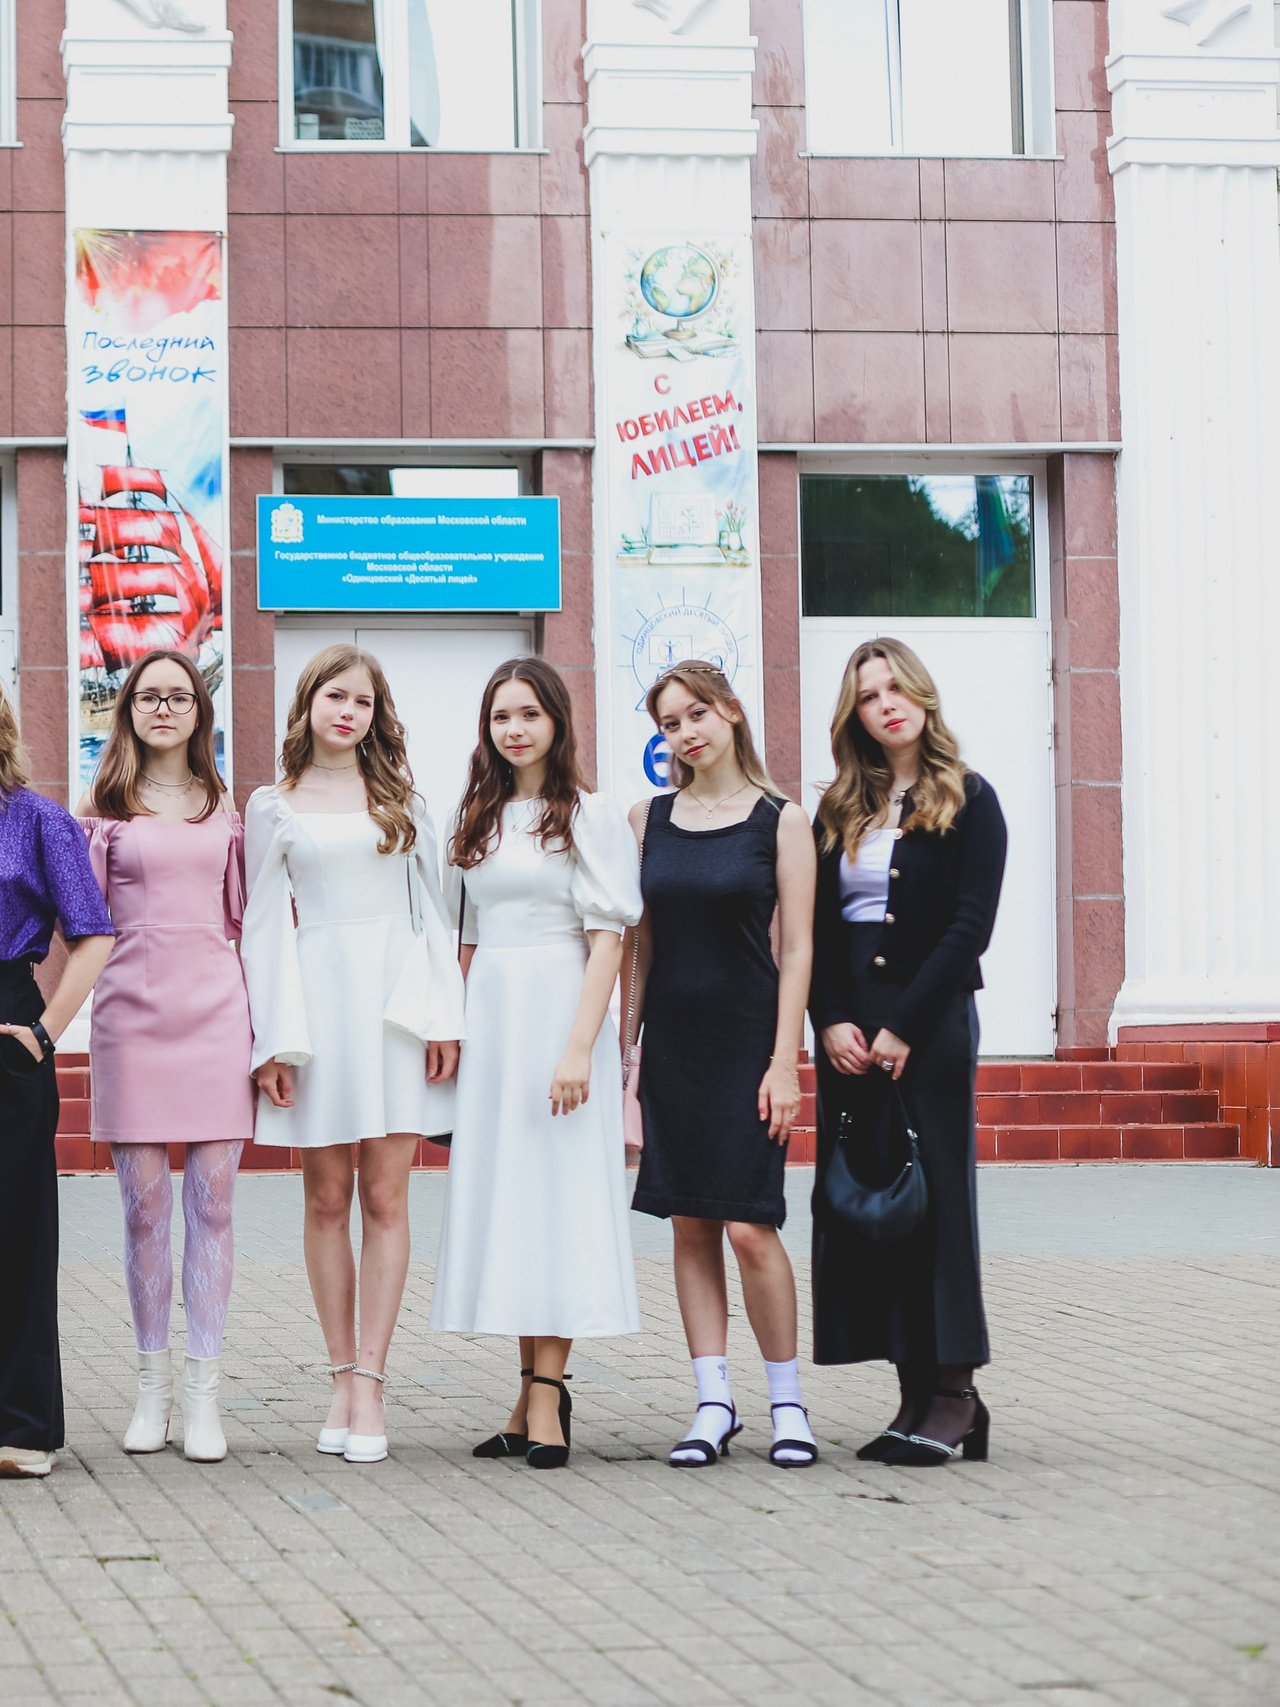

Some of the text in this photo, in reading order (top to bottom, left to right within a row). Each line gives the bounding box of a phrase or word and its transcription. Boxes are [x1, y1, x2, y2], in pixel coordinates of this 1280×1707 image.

[82, 331, 215, 363] Последний
[616, 390, 743, 443] ЮБИЛЕЕМ,
[631, 423, 741, 480] ЛИЦЕЙ!
[317, 515, 527, 526] Министерство образования Московской области
[274, 551, 545, 563] Государственное бюджетное общеобразовательное учреждение
[366, 562, 454, 572] Московской области
[342, 573, 478, 584] «Одинцовский «Десятый лицей»
